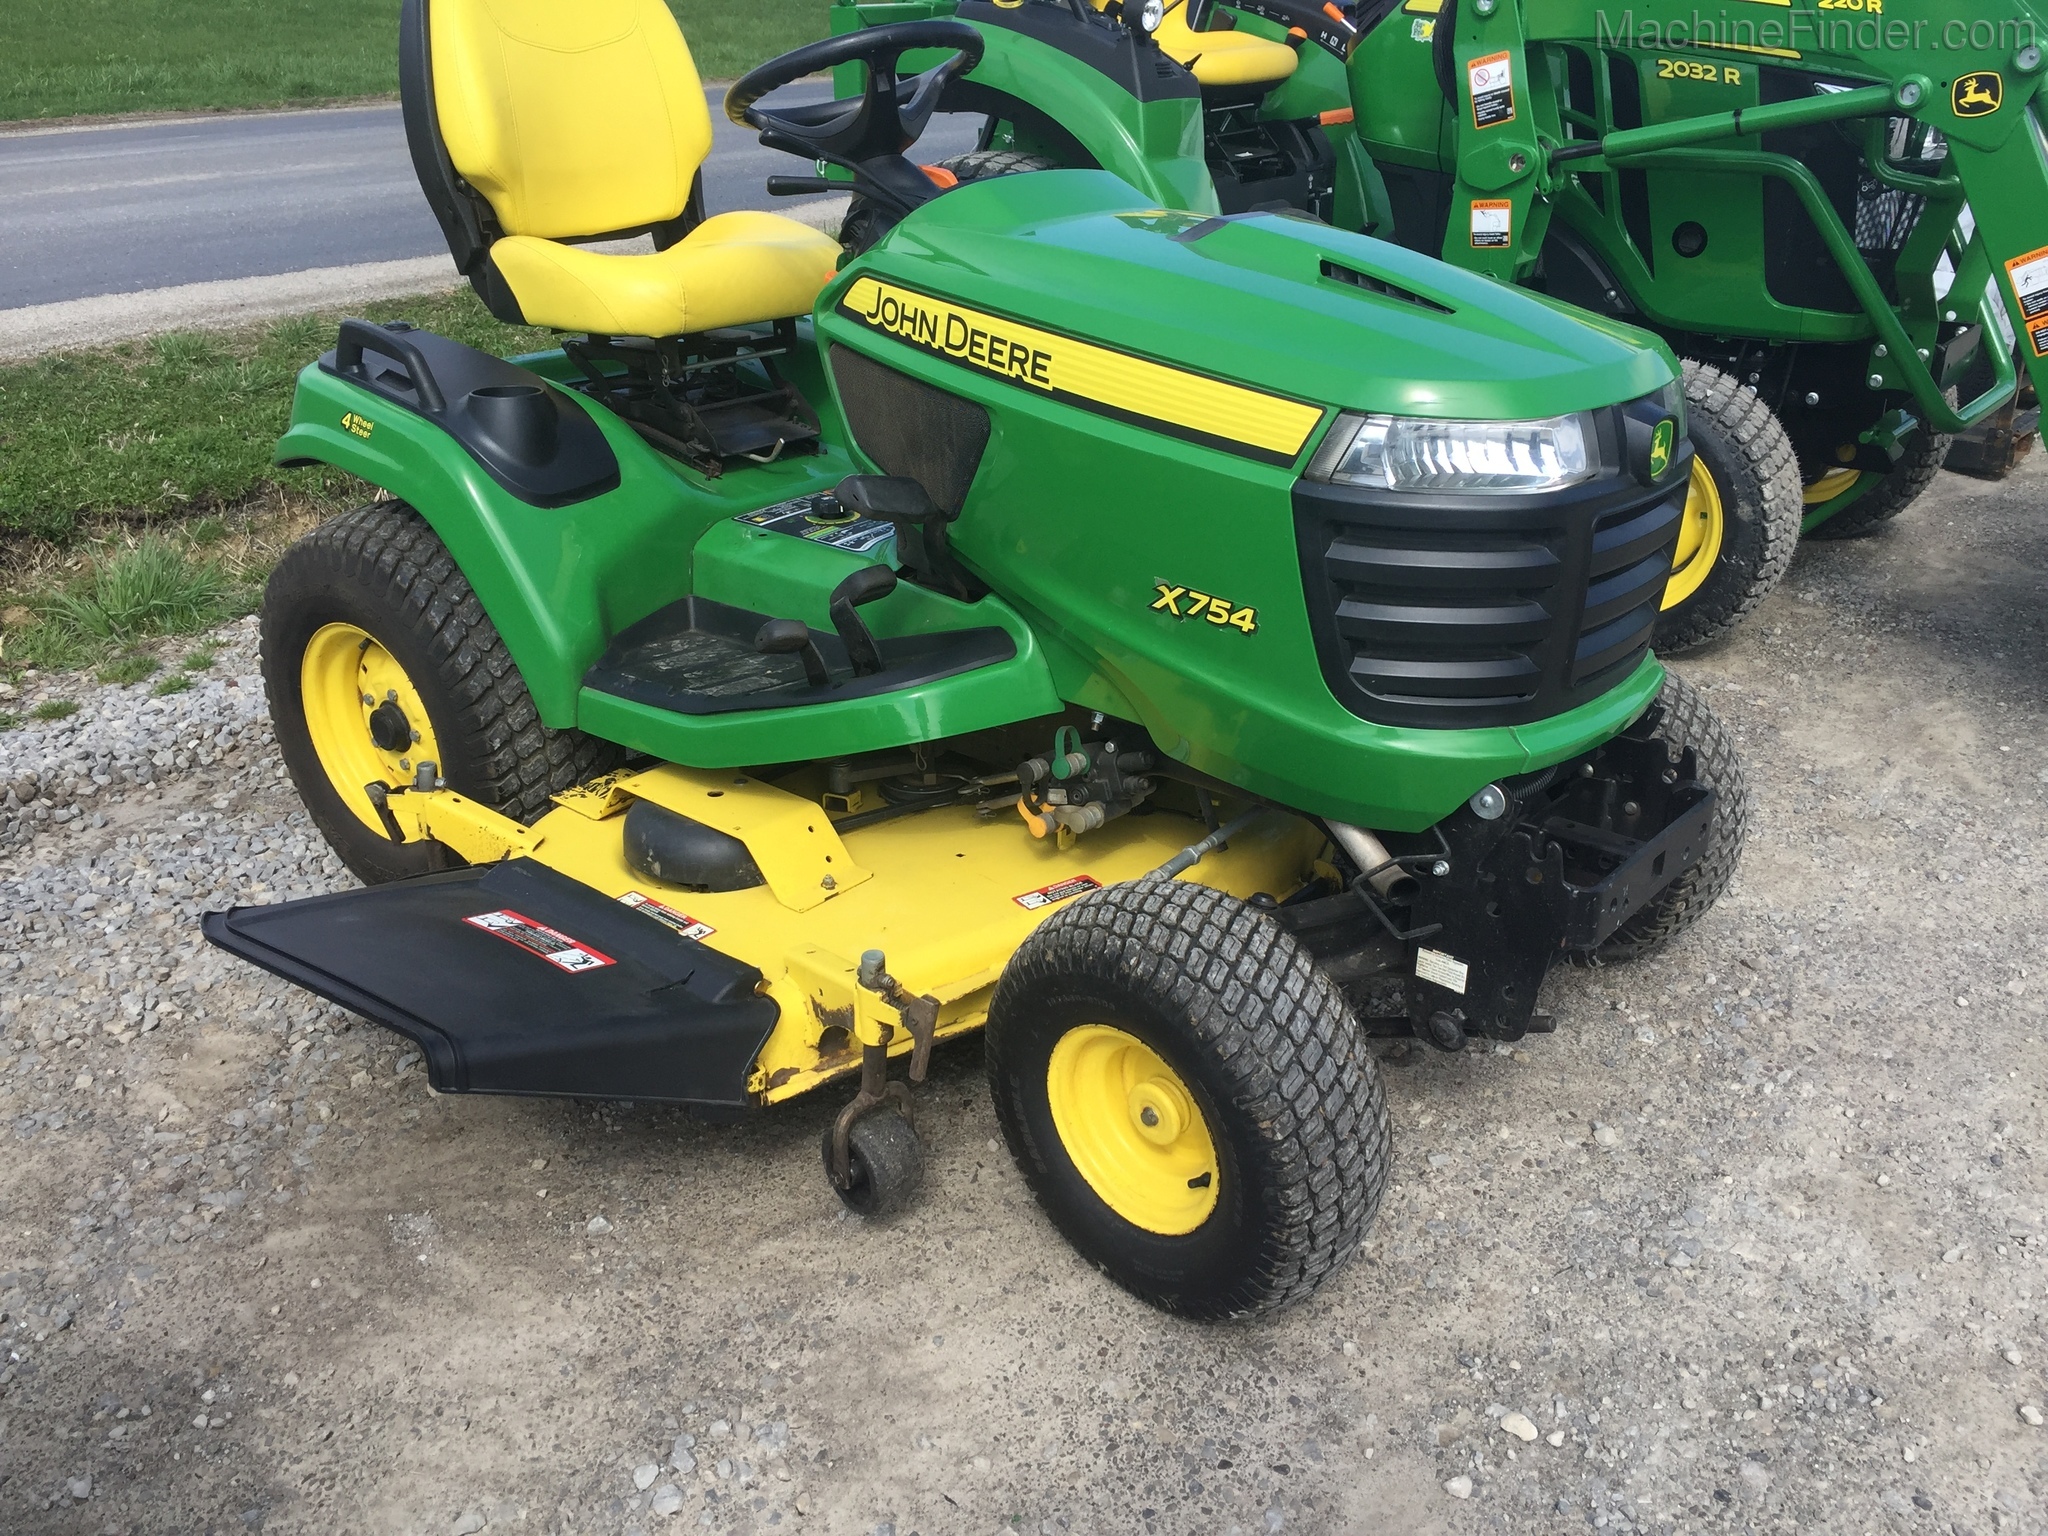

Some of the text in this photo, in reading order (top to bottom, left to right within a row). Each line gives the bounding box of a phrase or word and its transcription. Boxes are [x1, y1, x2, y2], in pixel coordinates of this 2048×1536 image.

[1867, 0, 1883, 14] R
[1320, 30, 1327, 39] H
[1477, 53, 1508, 66] WARNING
[1657, 59, 1741, 86] 2032 R
[866, 286, 1052, 385] JOHN DEERE
[341, 412, 374, 430] 4 Wheel
[351, 423, 371, 438] Steer
[1151, 585, 1256, 632] X754
